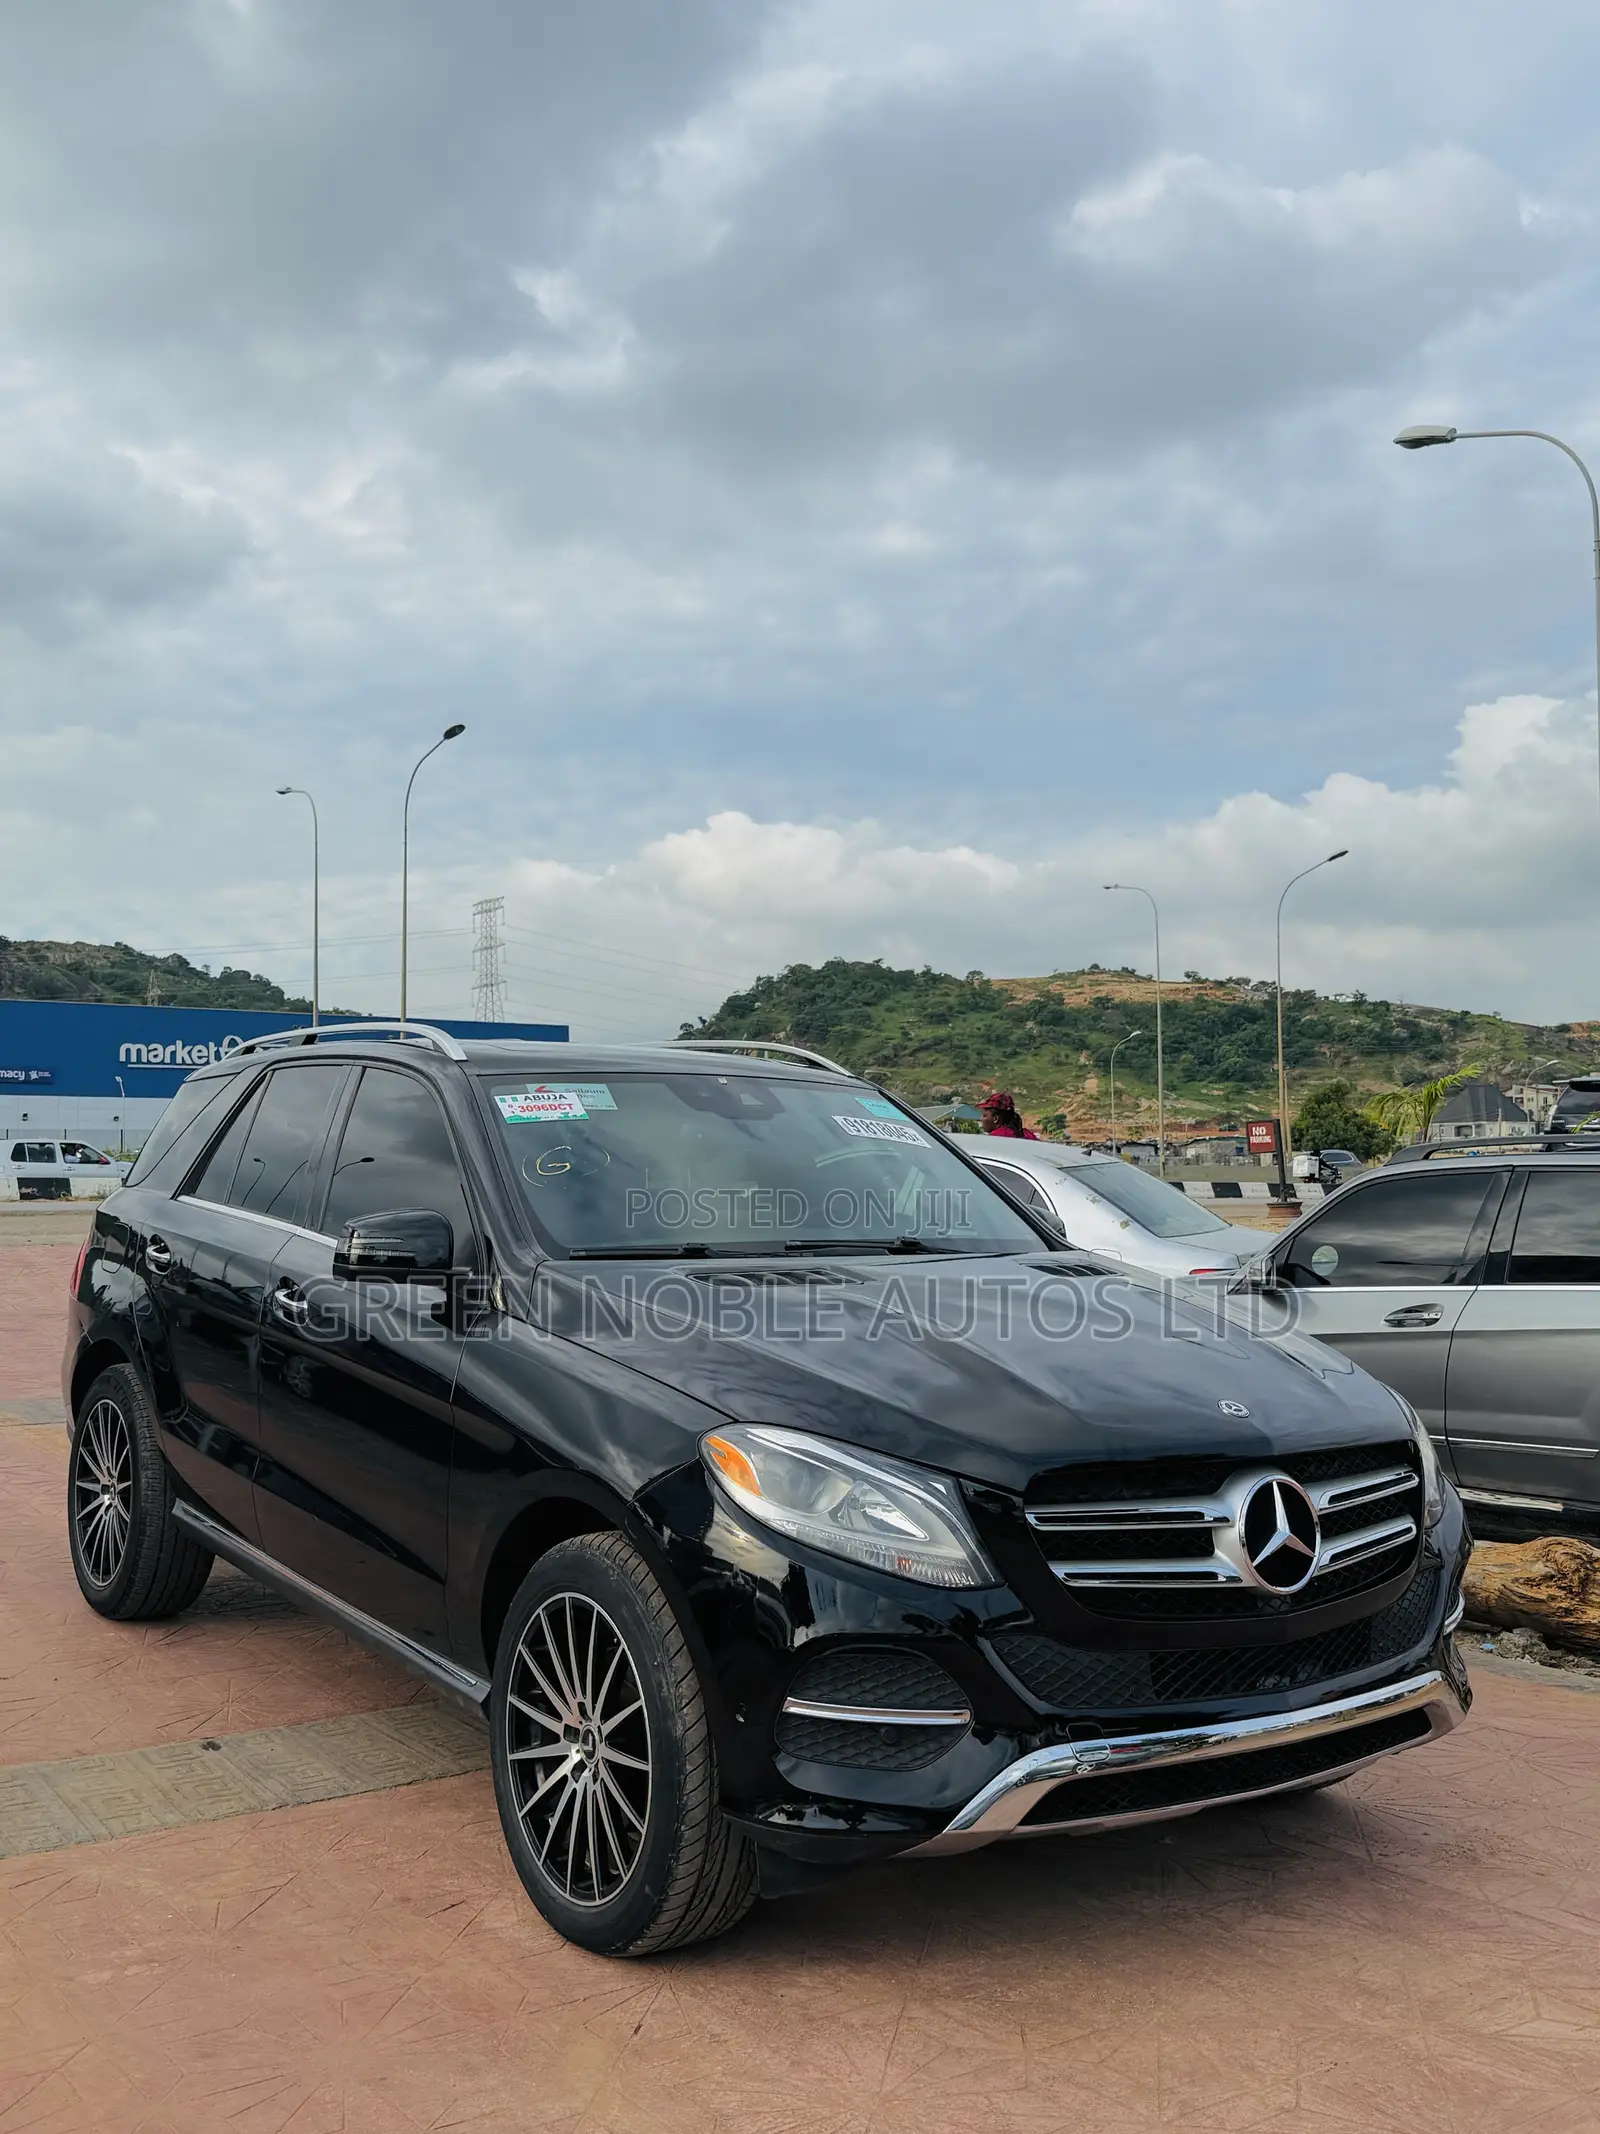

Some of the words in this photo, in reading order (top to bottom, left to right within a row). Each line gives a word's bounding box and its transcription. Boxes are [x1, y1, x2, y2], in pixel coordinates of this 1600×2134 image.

[523, 1093, 568, 1102] ABUJA
[1252, 1126, 1266, 1135] NO
[1250, 1135, 1272, 1144] PARKING
